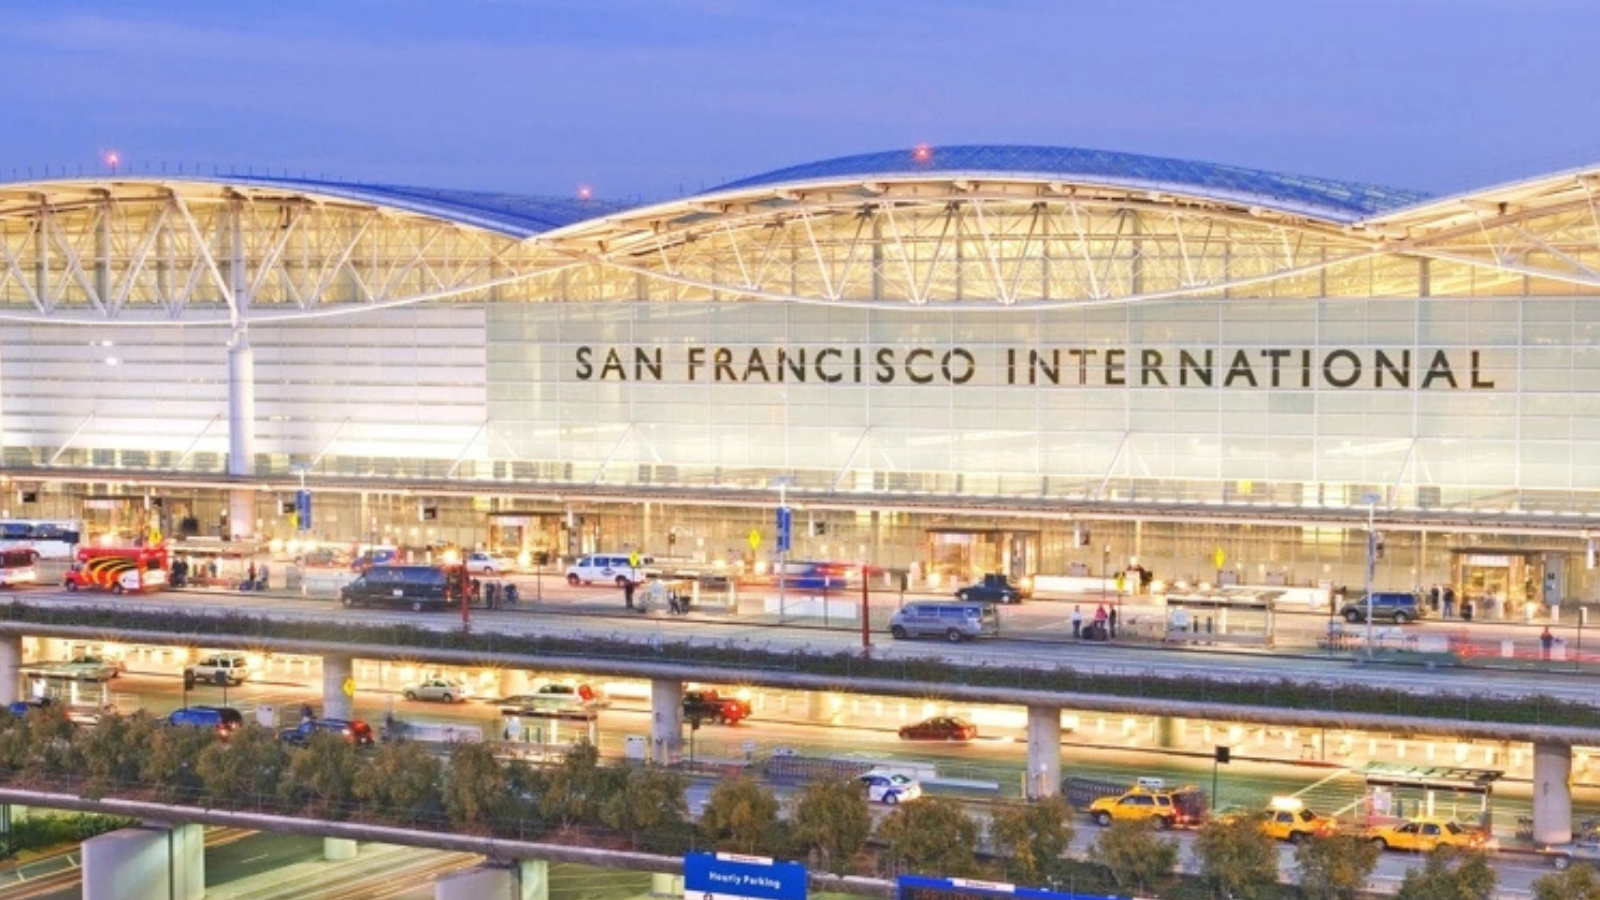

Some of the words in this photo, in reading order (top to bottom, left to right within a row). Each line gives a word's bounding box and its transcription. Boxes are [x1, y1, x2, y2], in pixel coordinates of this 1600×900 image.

[575, 346, 663, 381] SAN
[688, 347, 974, 384] FRANCISCO
[1008, 348, 1495, 388] INTERNATIONAL
[709, 871, 741, 885] Hourly
[744, 875, 780, 889] Parking
